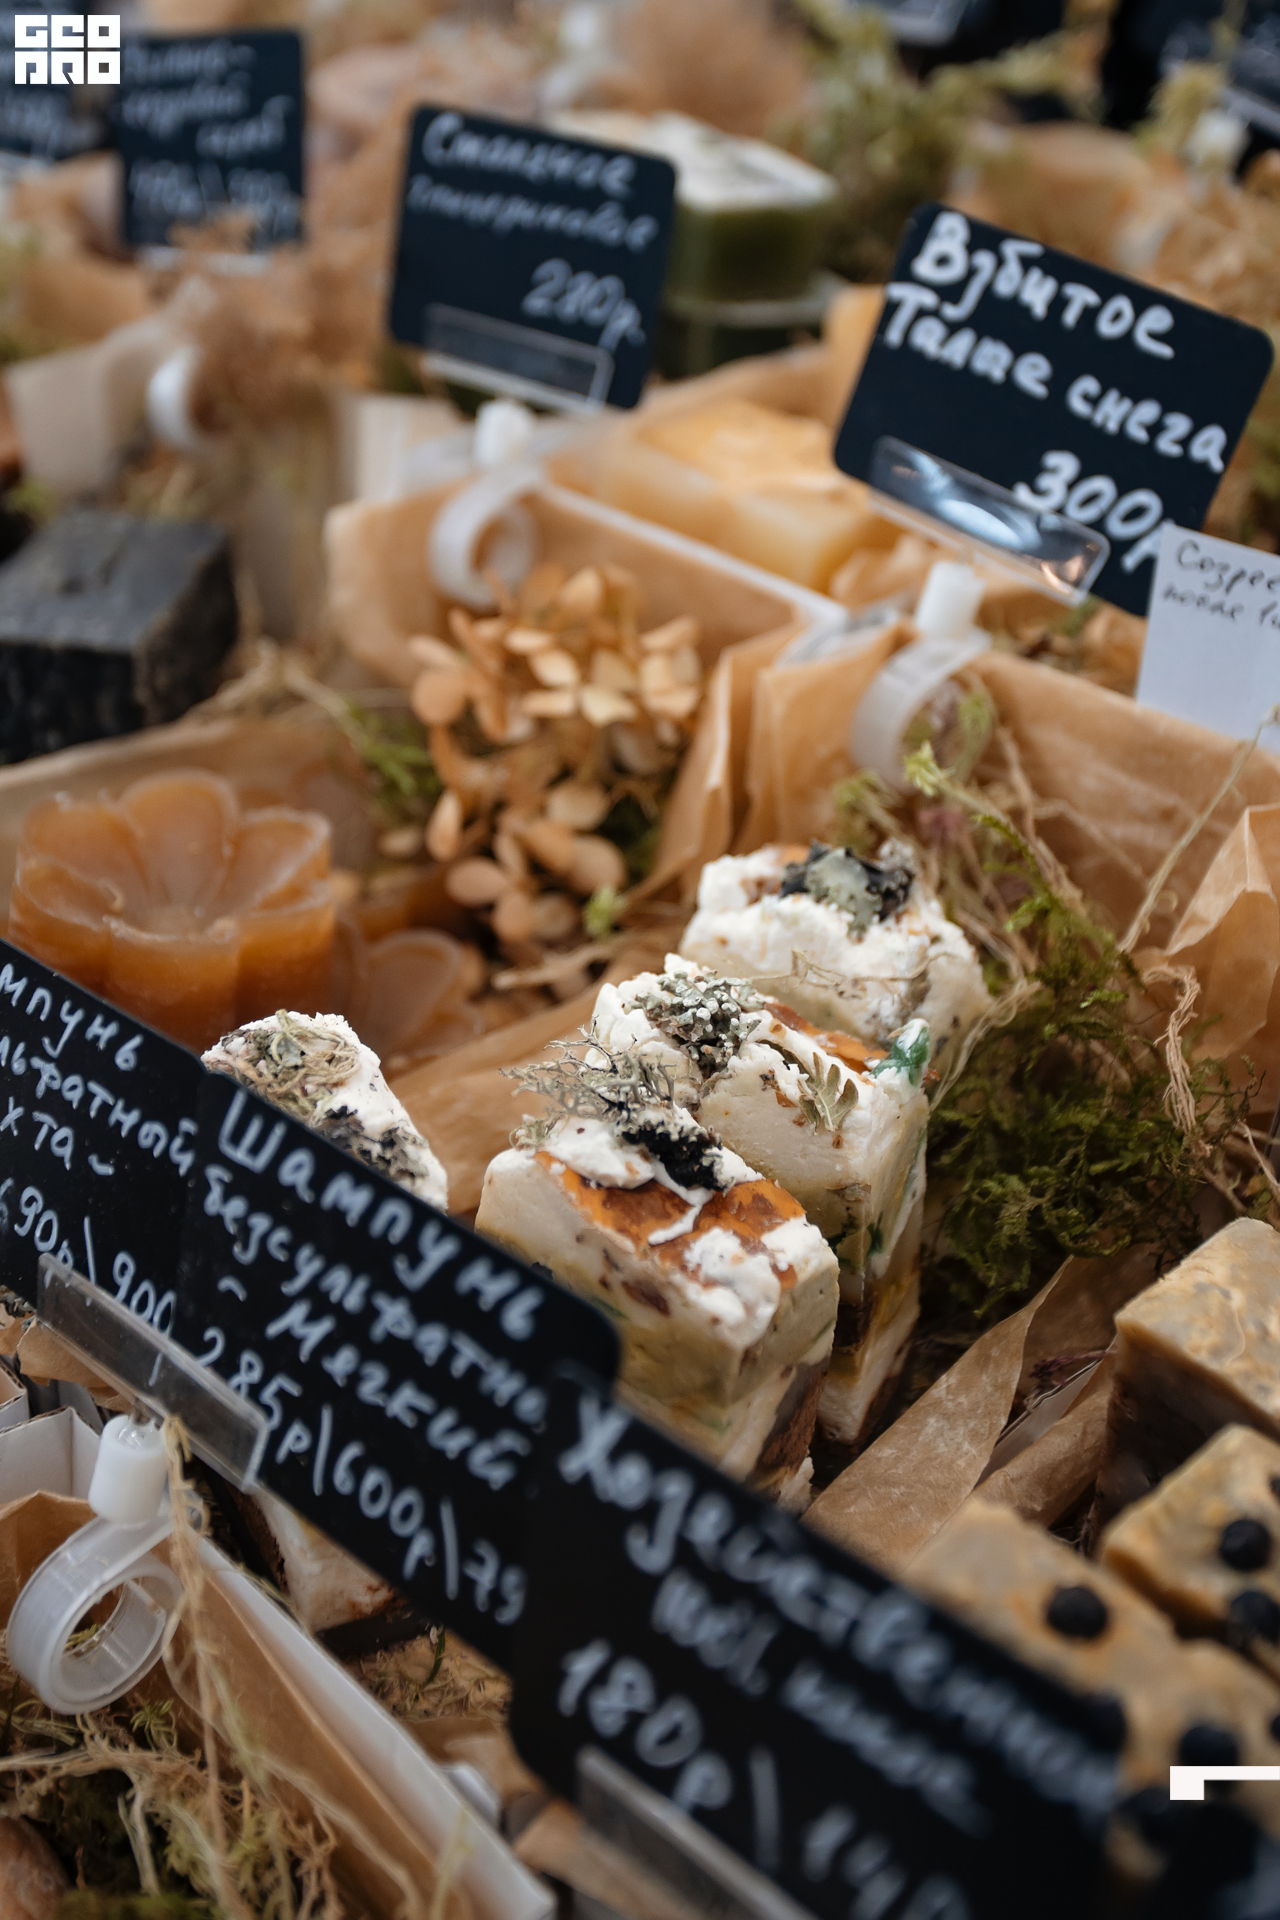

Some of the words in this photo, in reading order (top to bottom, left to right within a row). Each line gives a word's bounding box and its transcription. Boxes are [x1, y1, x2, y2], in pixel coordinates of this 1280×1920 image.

[911, 210, 1175, 359] Взбитое
[1066, 374, 1228, 474] снега
[218, 1088, 545, 1341] Шампунь
